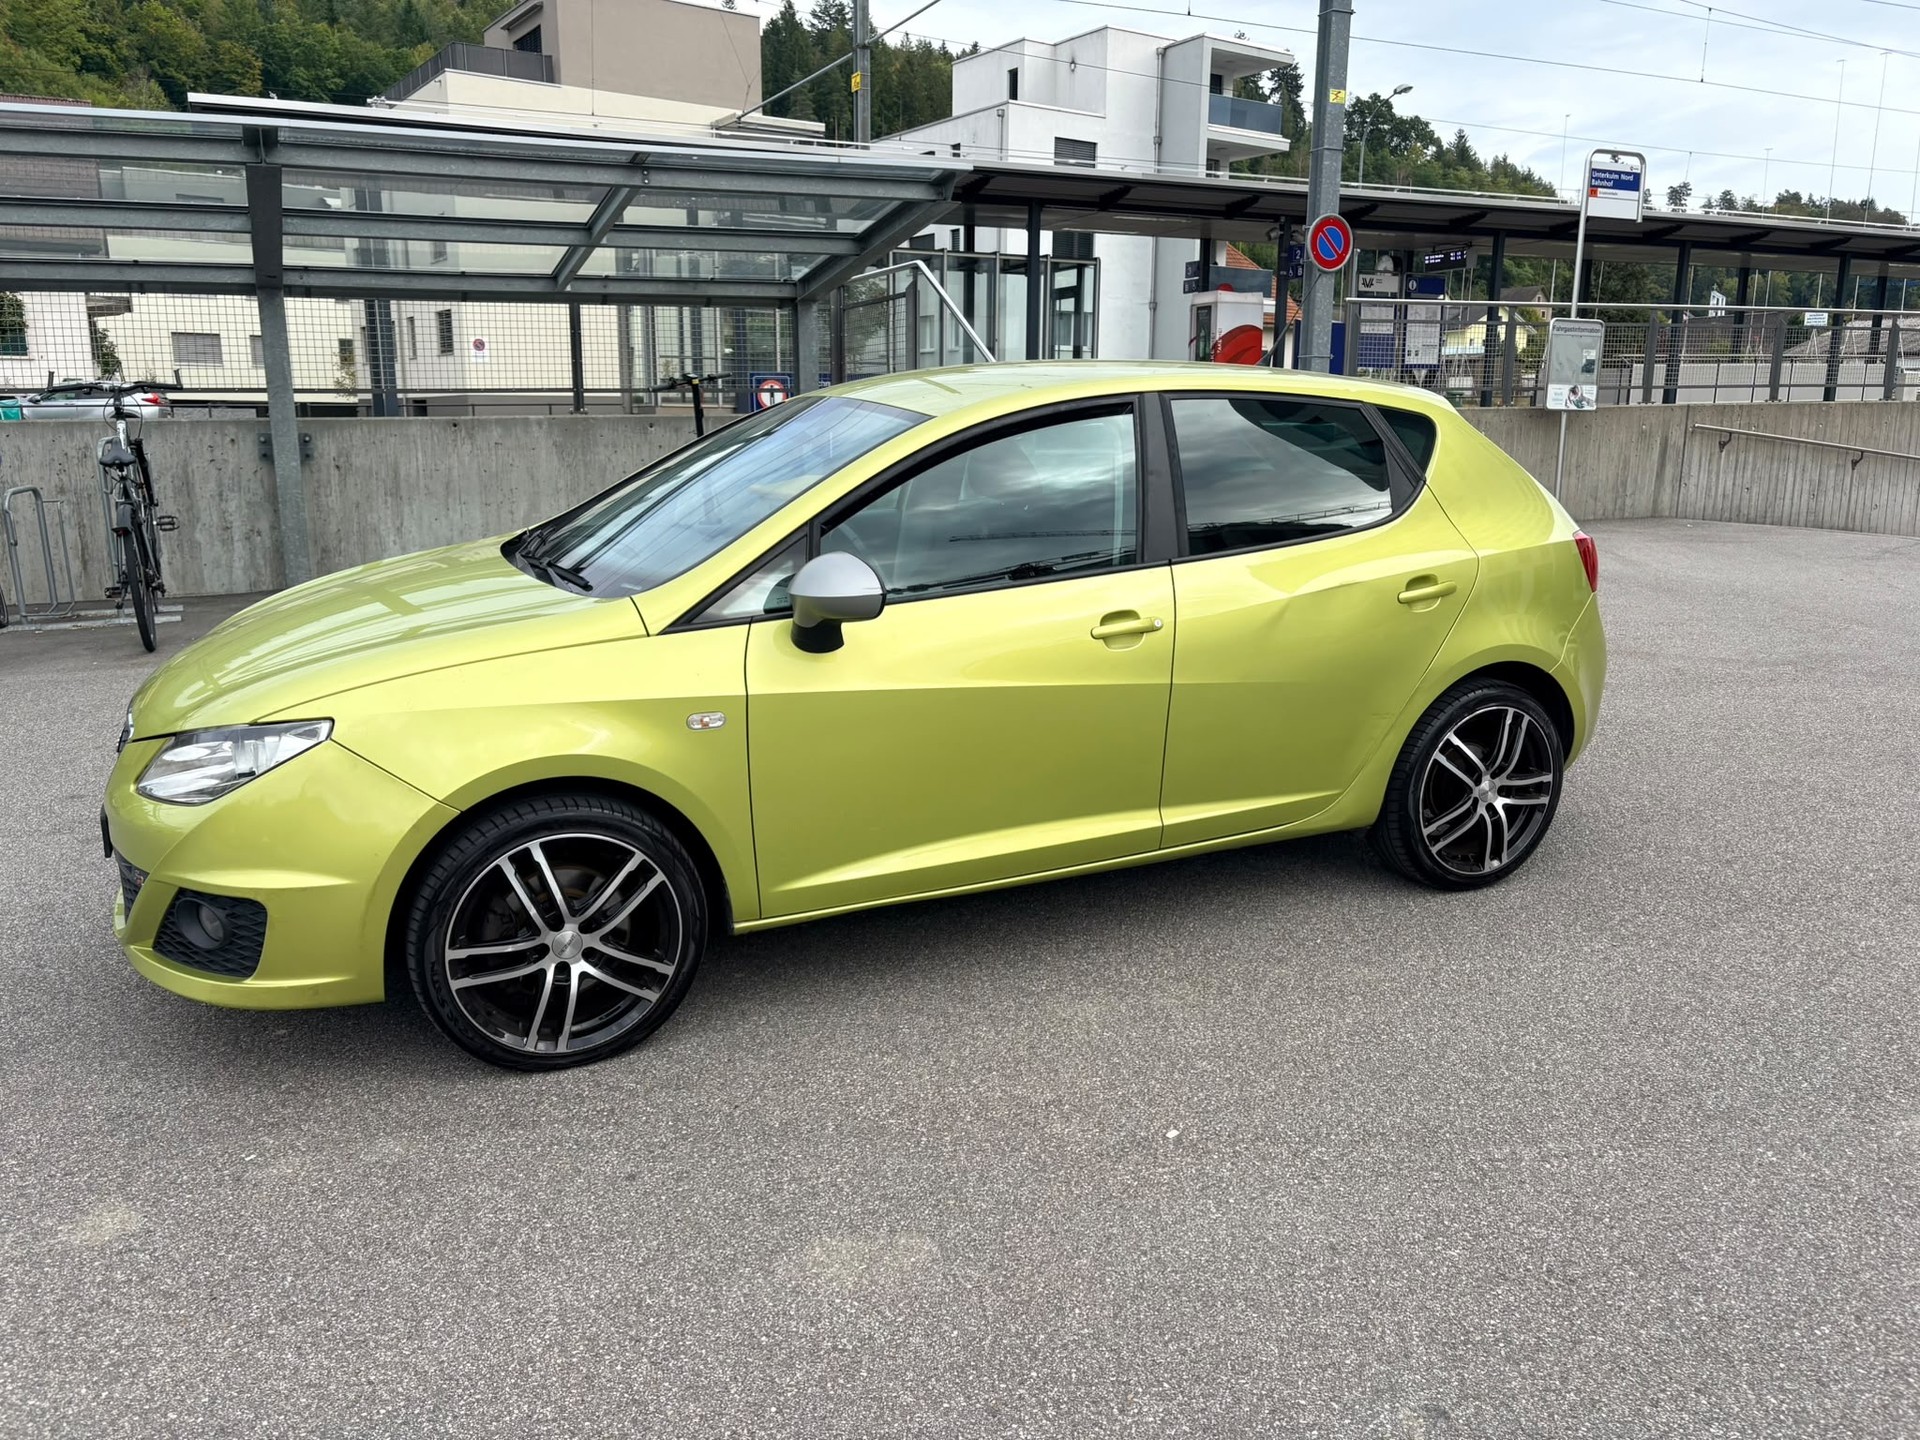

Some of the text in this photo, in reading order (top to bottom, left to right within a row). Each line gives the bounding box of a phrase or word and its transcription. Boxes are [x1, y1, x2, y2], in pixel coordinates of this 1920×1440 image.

[1620, 173, 1634, 181] Nord
[1592, 178, 1614, 187] Bahnhof
[1296, 249, 1301, 259] 2
